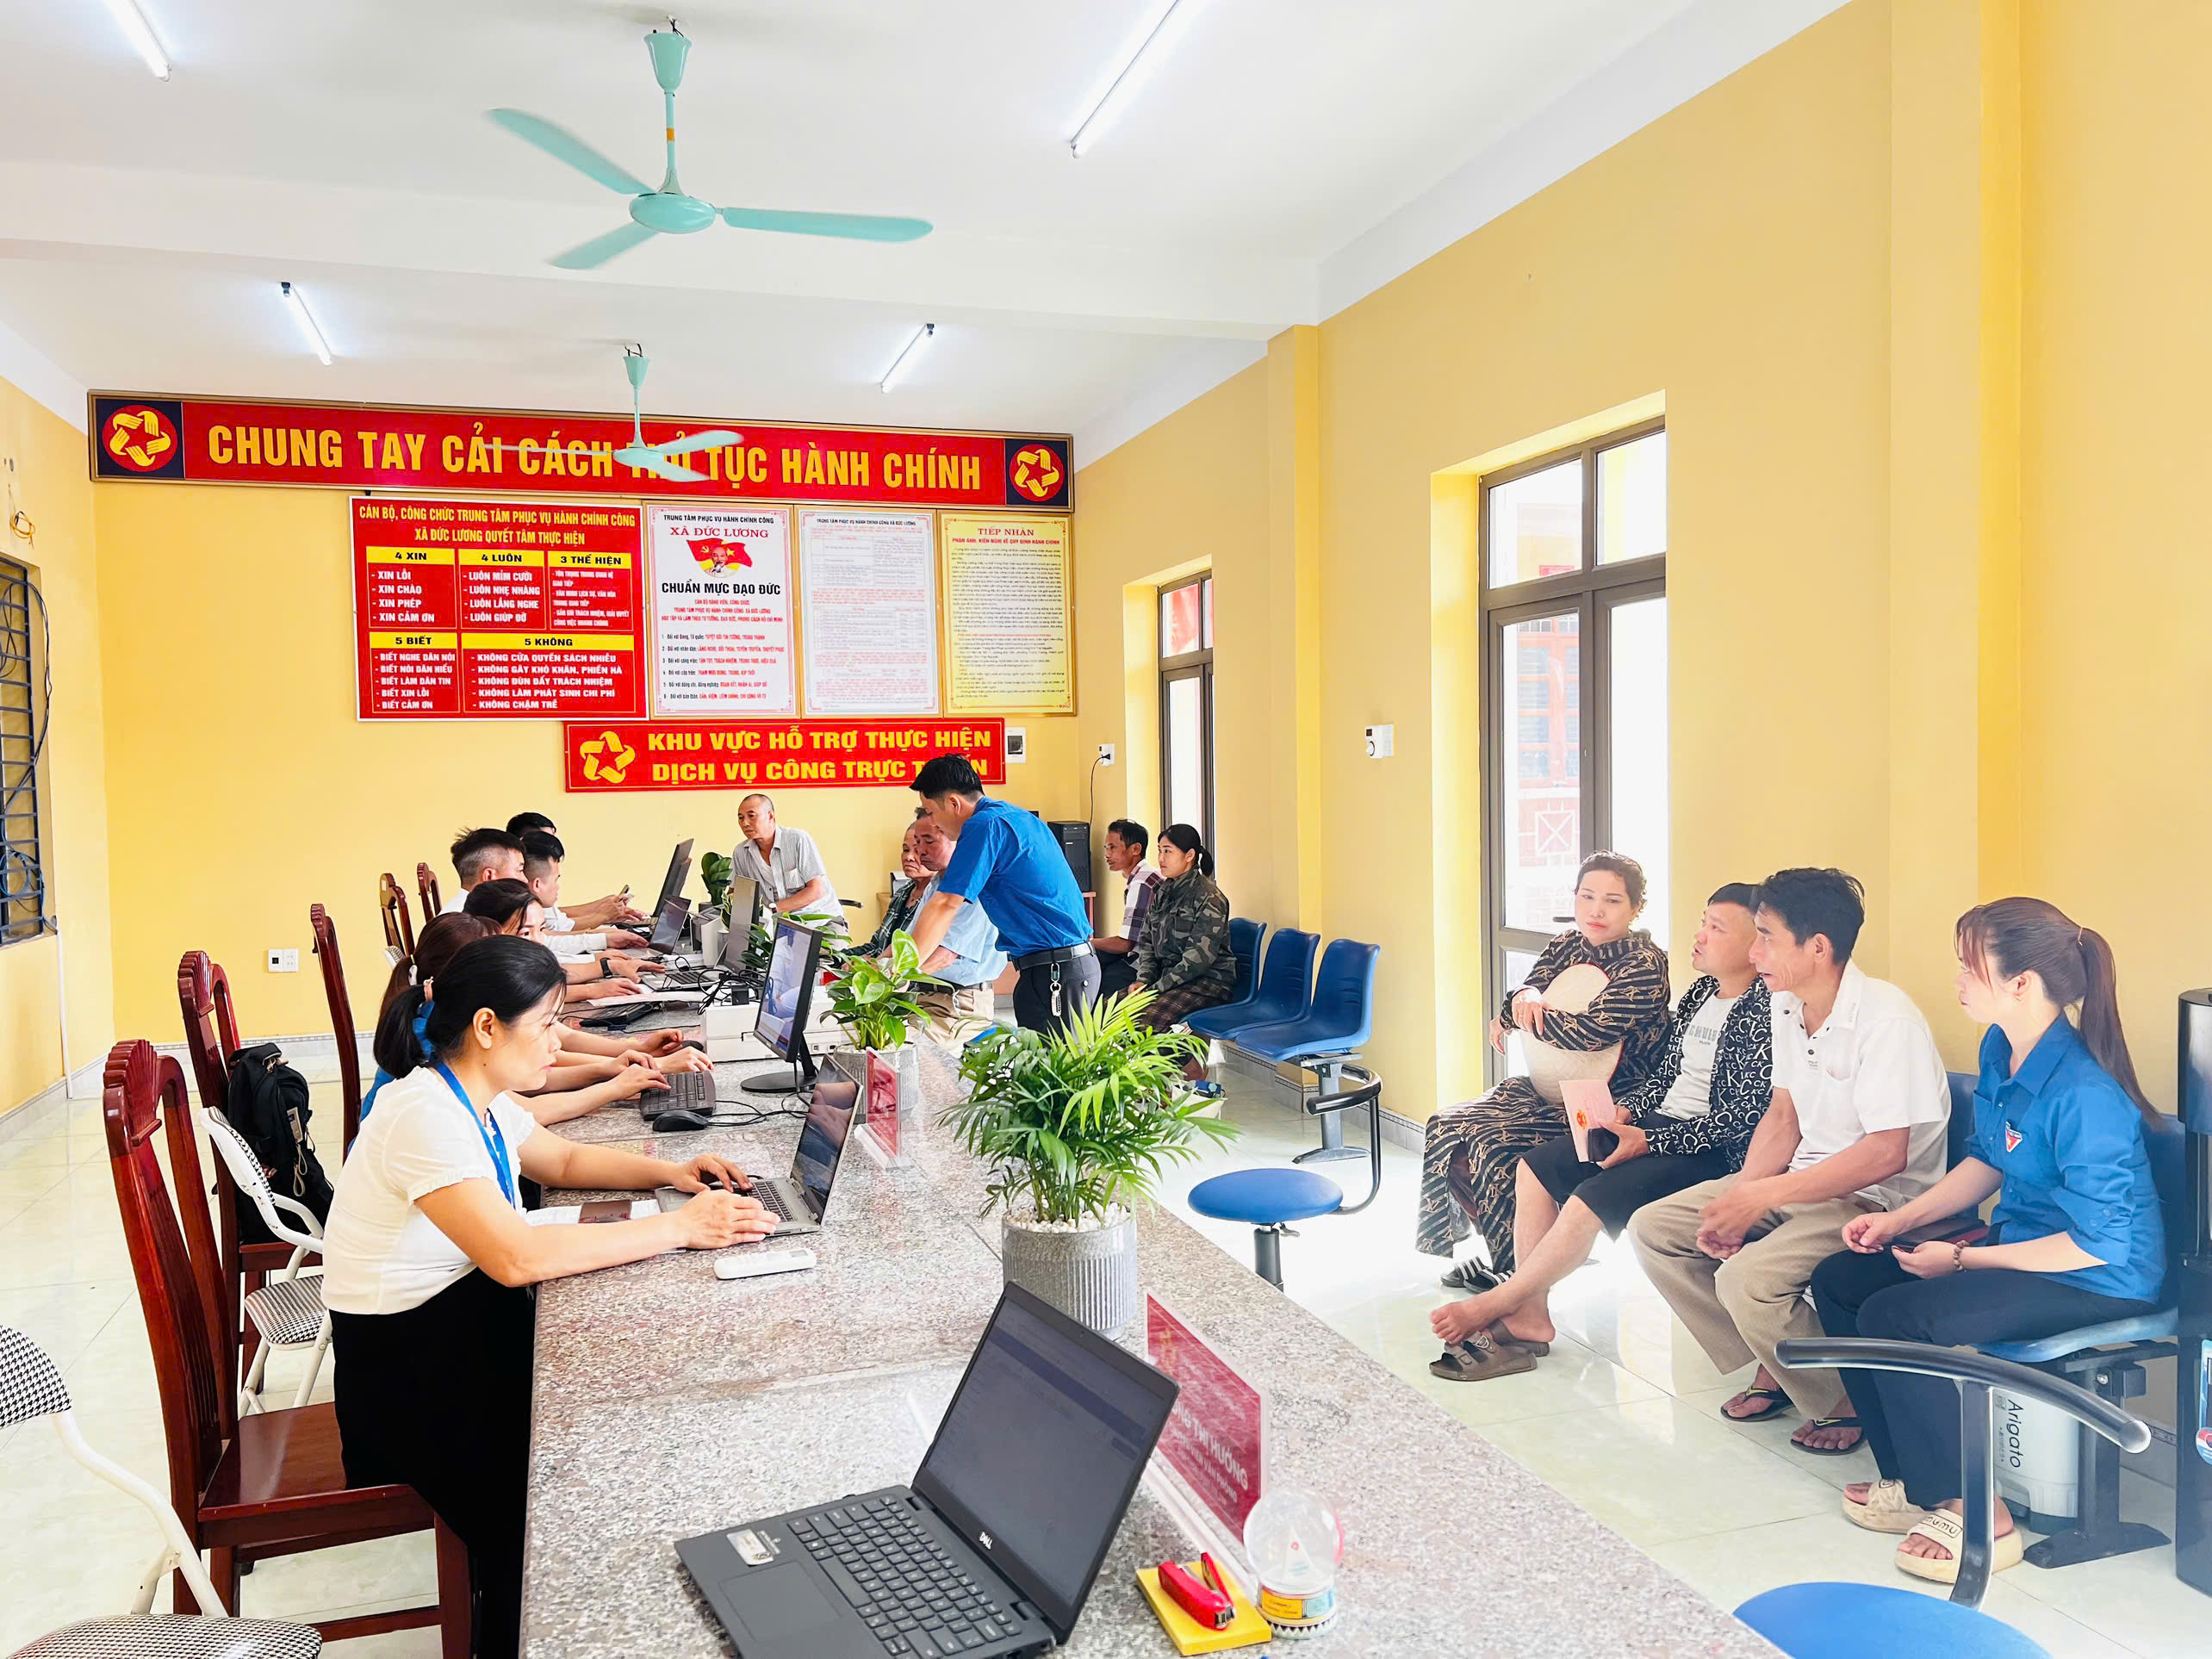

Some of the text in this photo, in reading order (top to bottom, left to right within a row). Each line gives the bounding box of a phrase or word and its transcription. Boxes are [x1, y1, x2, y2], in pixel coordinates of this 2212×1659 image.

[208, 426, 343, 468] CHUNG
[357, 432, 426, 470] TAY
[442, 422, 503, 473] CẢI
[519, 431, 612, 478] CÁCH
[705, 445, 767, 488] TỤC
[781, 442, 869, 487] HÀNH
[883, 447, 980, 490] CHÍNH
[359, 504, 379, 519] CÁN
[401, 506, 426, 520] CÔNG
[430, 506, 454, 521] CHỨC
[457, 509, 488, 522] TRUNG
[490, 508, 510, 523] TÂM
[513, 511, 537, 525] PHỤC
[540, 512, 551, 526] VỤ
[554, 510, 578, 525] HÀNH
[581, 512, 608, 526] CHÍNH
[611, 513, 635, 526] CÔNG
[670, 526, 768, 537] XÃ ĐỨC LƯƠNG
[978, 526, 1001, 535] TIẾP
[415, 526, 585, 547] XÃ ĐỨC LƯƠNG QUYẾT TÂM THỰC HIỆN
[493, 553, 522, 562] LUÔN
[595, 556, 621, 566] HIỆN
[469, 570, 490, 580] LUÔN
[469, 584, 490, 593] LUÔN
[494, 586, 509, 596] NHẸ
[662, 579, 780, 596] CHUẨN MỰC ĐẠO ĐỨC
[398, 598, 421, 608] PHÉP
[470, 598, 491, 607] LUÔN
[517, 600, 538, 609] NGHE
[470, 612, 491, 621] LUÔN
[494, 612, 513, 622] GIÚP
[407, 635, 432, 644] BIẾT
[535, 637, 573, 646] KHÔNG
[380, 652, 397, 661] BIẾT
[381, 663, 397, 673] BIẾT
[478, 665, 508, 674] KHÔNG
[381, 675, 398, 685] BIẾT
[553, 677, 581, 686] TRÁCH
[584, 678, 612, 687] NHIỆM
[382, 687, 399, 697] BIẾT
[382, 699, 400, 709] BIẾT
[479, 700, 510, 709] KHÔNG
[513, 701, 539, 710] CHẬM
[648, 725, 991, 753] KHU VỰC HỖ TRỢ THỰC HIỆN
[653, 763, 715, 784] DỊCH
[724, 762, 757, 783] VỤ
[766, 758, 836, 780] CÔNG
[843, 760, 905, 781] TRỰC
[2006, 1399, 2024, 1468] Arigato
[979, 1532, 992, 1550] DELL
